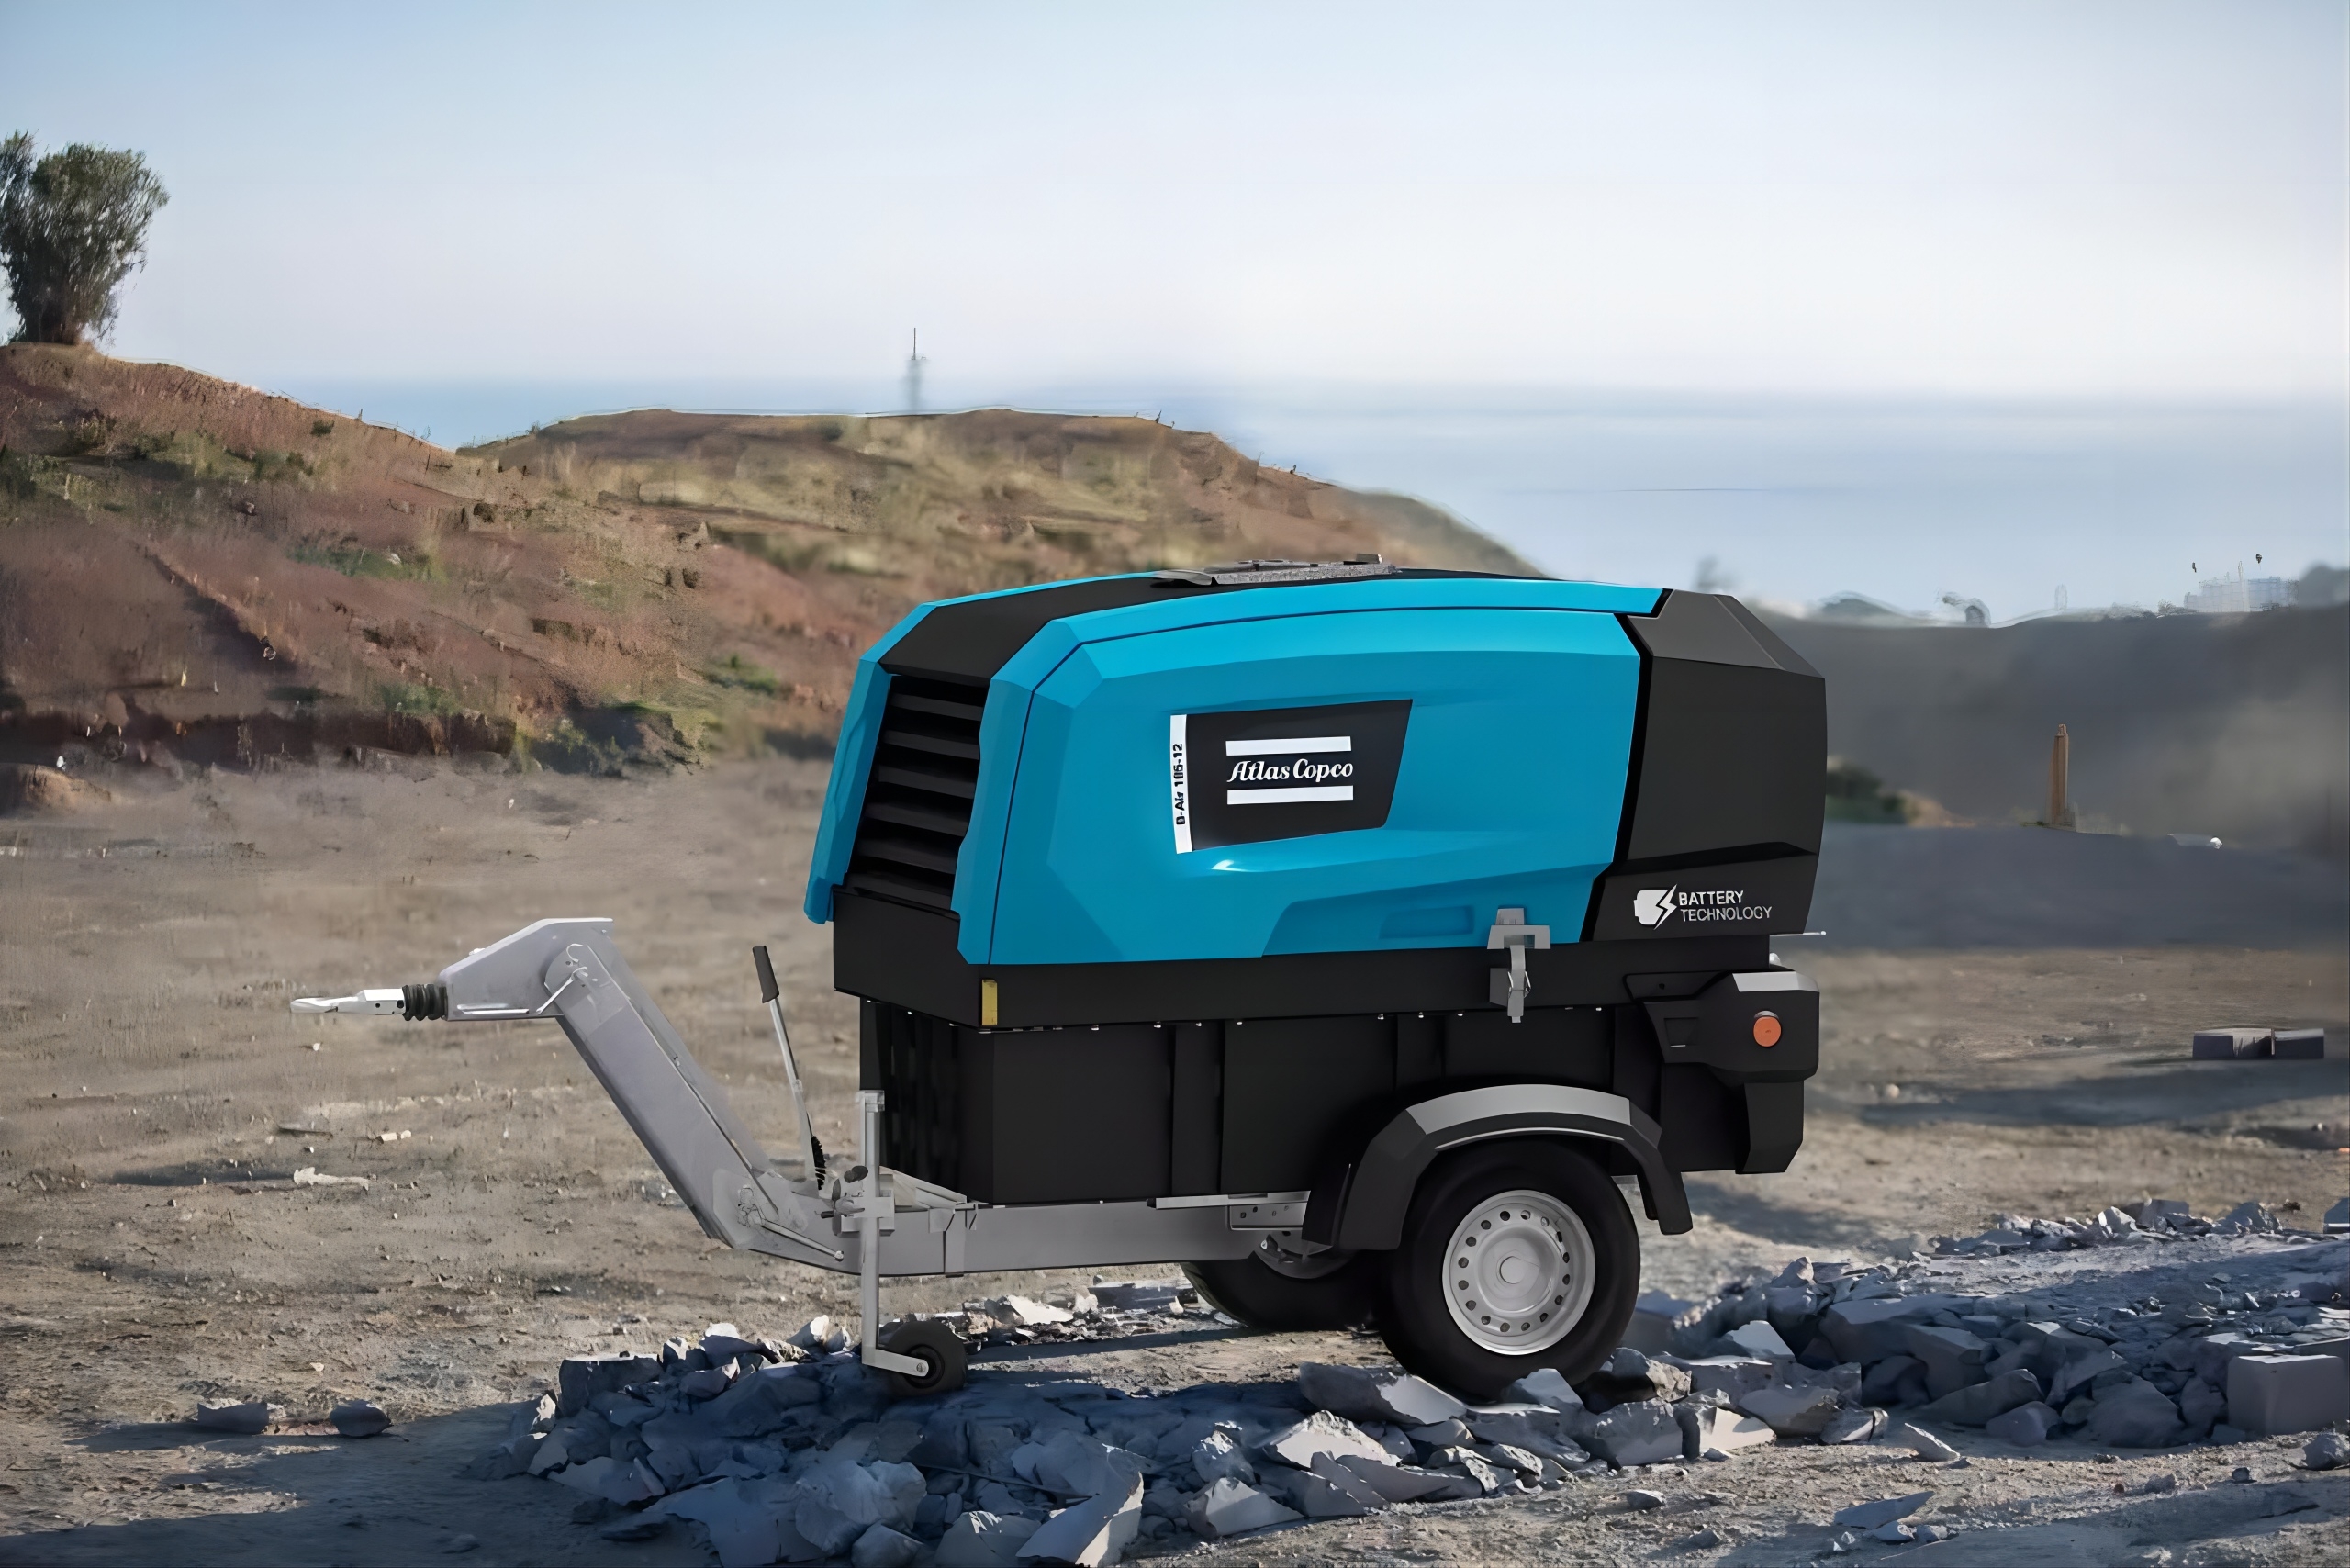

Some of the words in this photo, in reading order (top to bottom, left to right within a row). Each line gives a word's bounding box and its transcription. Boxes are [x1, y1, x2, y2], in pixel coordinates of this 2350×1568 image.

[1226, 760, 1290, 782] Atlas
[1292, 758, 1353, 782] Copco
[1679, 890, 1744, 906] BATTERY
[1680, 906, 1773, 922] TECHNOLOGY
